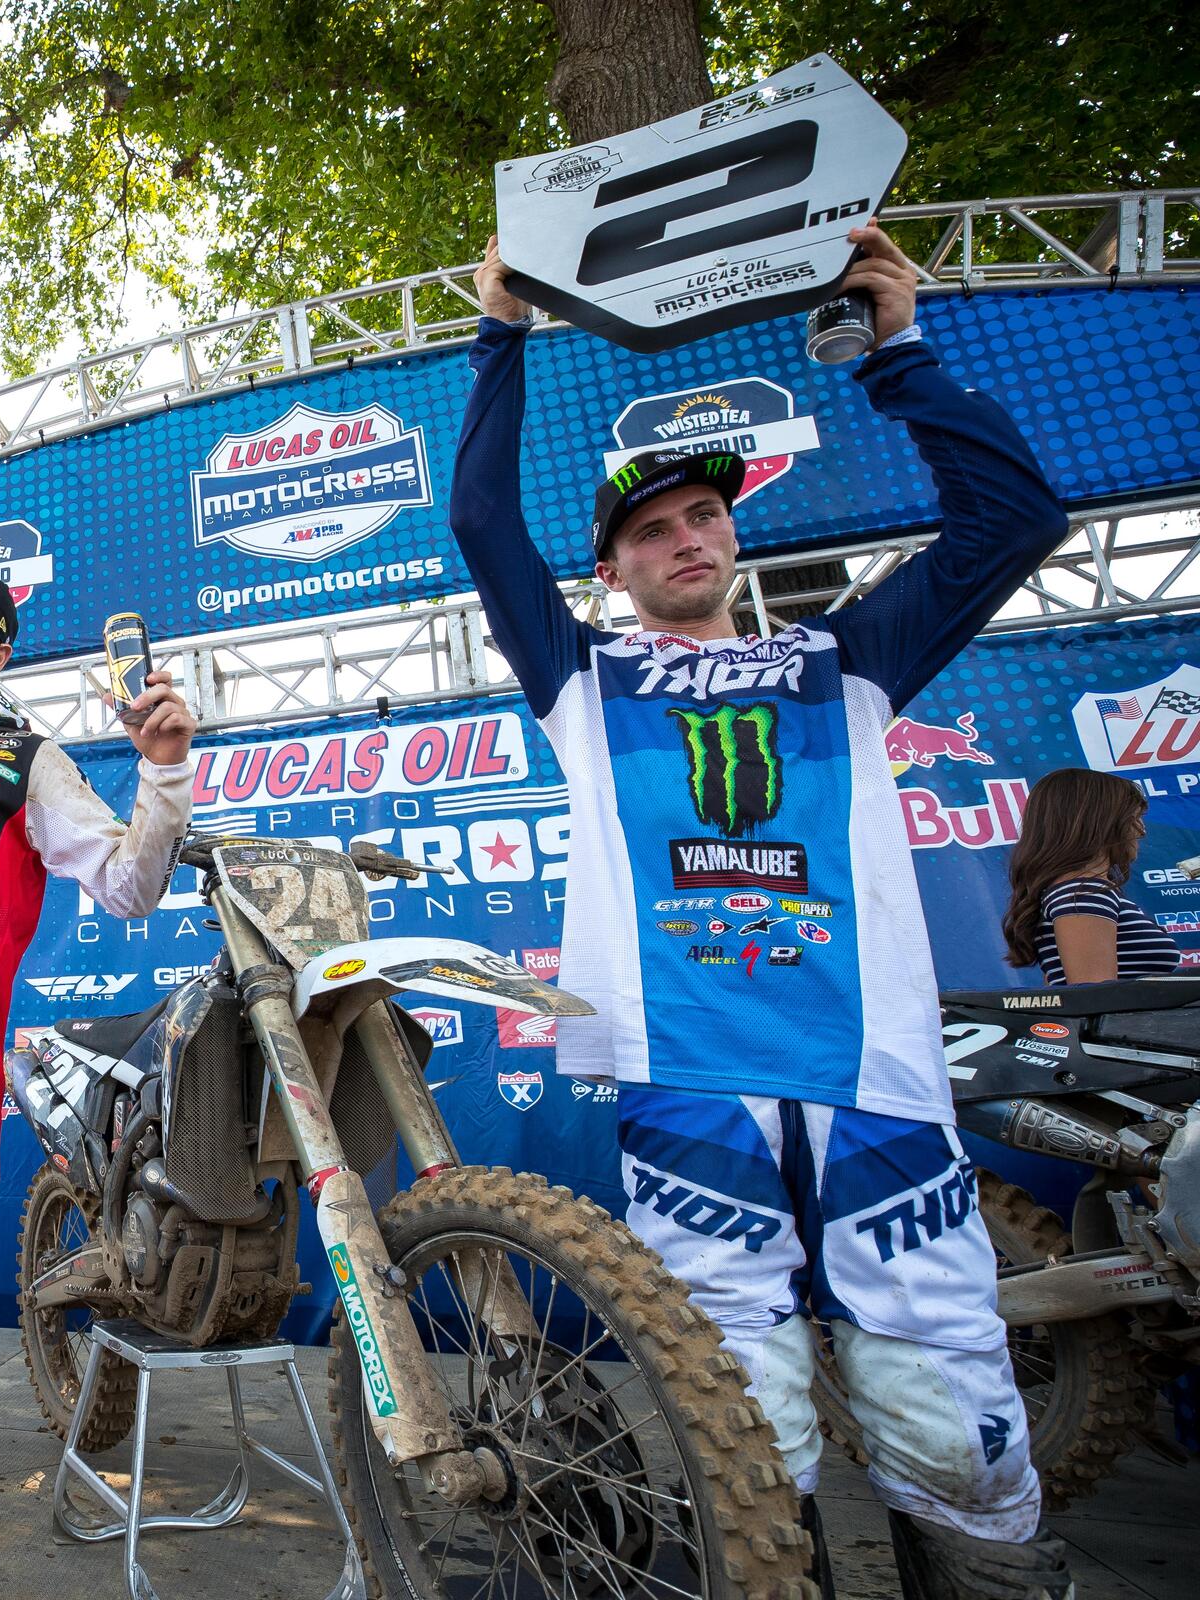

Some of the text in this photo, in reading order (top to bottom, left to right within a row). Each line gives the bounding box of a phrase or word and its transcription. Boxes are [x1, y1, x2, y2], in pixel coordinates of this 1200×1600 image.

[547, 160, 601, 185] REDBUD
[686, 259, 770, 289] LUCAS OIL
[655, 264, 816, 315] MOTOCROSS
[653, 408, 751, 440] TWISTED TEA
[228, 418, 378, 470] LUCAS OIL
[204, 459, 417, 517] MOTOCROSS
[278, 465, 333, 482] PRO
[641, 473, 681, 496] YAMAHA
[205, 480, 418, 526] CHAMPIONSHIP
[282, 523, 343, 544] AMA PRO
[197, 556, 445, 614] @promotocross
[634, 654, 805, 700] THOR
[193, 718, 515, 806] LUCAS OIL
[269, 799, 422, 832] PRO
[898, 779, 1031, 848] Bull
[167, 836, 183, 871] ENERGY
[679, 844, 799, 877] YAMALUBE
[247, 863, 361, 942] 24
[653, 897, 717, 911] GYTR
[730, 897, 766, 908] BELL
[685, 945, 723, 962] A60
[24, 973, 139, 997] FLY
[323, 959, 367, 981] FMF
[1002, 995, 1061, 1009] YAMAHA
[72, 1022, 93, 1030] GUTS
[518, 1035, 556, 1044] HOND
[500, 1076, 541, 1084] RACER
[509, 1083, 533, 1103] X
[631, 1164, 782, 1253] THOR
[1102, 1275, 1167, 1292] EXCEL
[341, 1283, 395, 1413] MOTOREX
